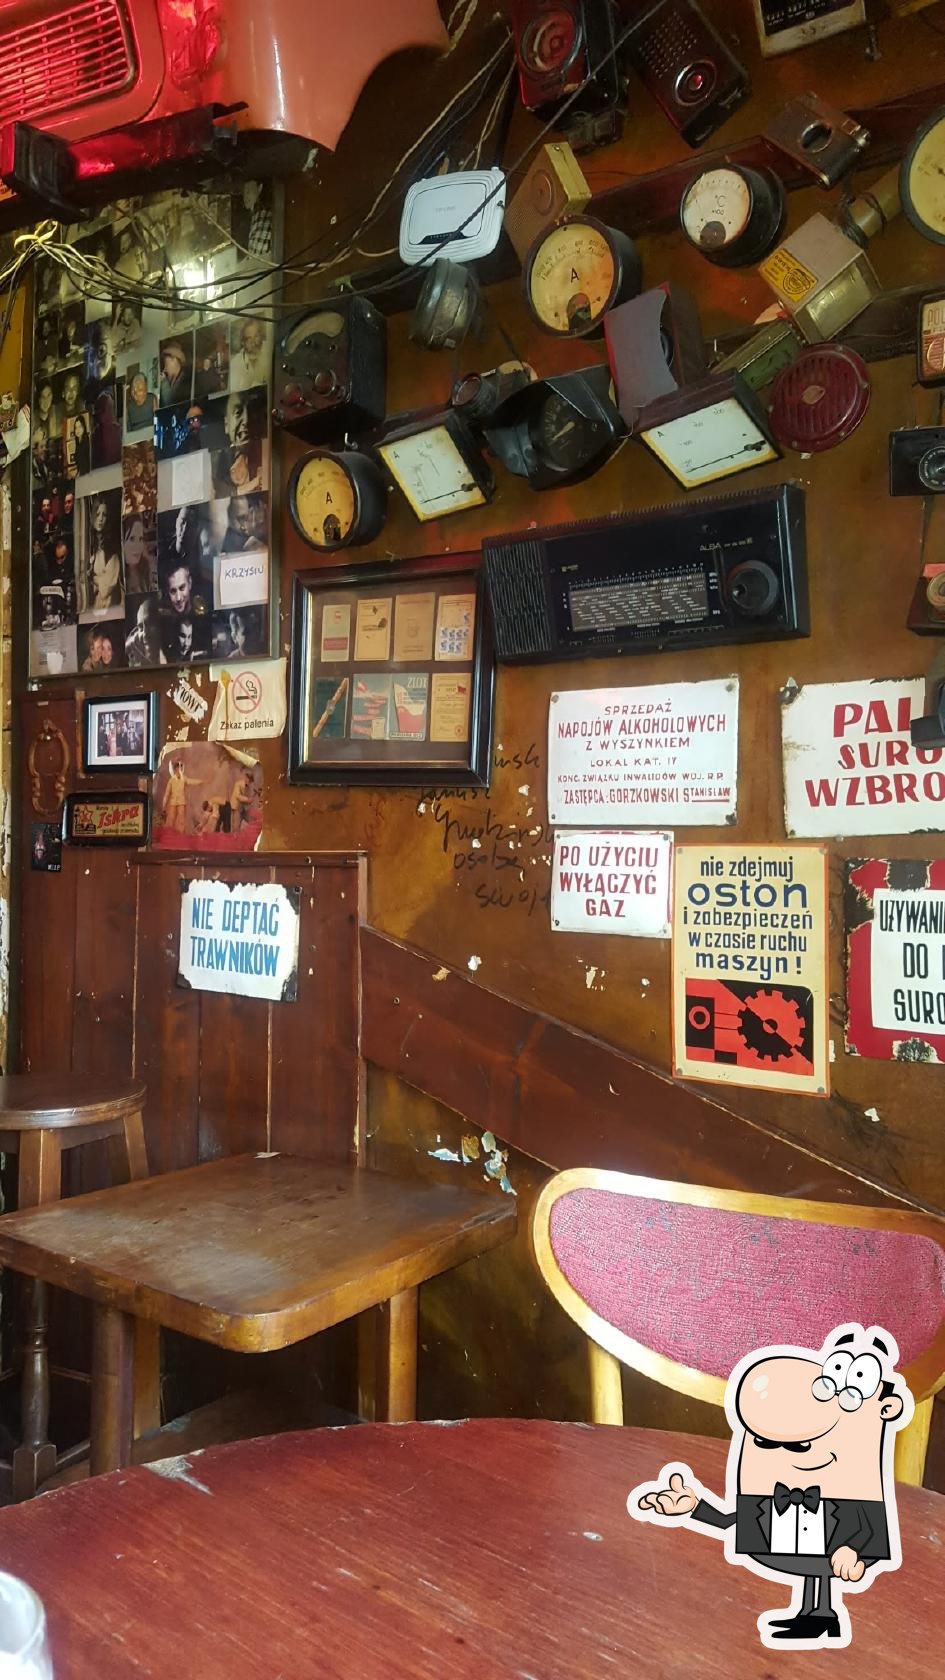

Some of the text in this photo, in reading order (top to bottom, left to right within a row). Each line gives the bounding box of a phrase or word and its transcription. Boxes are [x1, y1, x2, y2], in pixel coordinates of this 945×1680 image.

[570, 267, 580, 283] A
[325, 491, 333, 505] A
[604, 698, 672, 716] SPRZEDAŻ
[220, 718, 274, 731] Zakaz palenia
[558, 714, 726, 739] NAPOJÓW ALKOHOLOWYCH
[585, 737, 690, 751] Z WYSZYNKIEM
[590, 759, 628, 768] LOKAL
[634, 757, 661, 766] KAT.
[609, 787, 679, 804] GORZKOWSKI
[560, 841, 658, 867] PO UŻYCIU
[700, 856, 793, 882] nie zdejmuj
[559, 869, 657, 897] WYŁĄCZYĆ
[191, 897, 280, 937] NIE DEPTAĆ
[585, 898, 626, 917] GAZ
[683, 906, 813, 930] i zabezpieczeń
[879, 899, 945, 934] UŻYWANI
[705, 932, 756, 950] czasie
[760, 931, 807, 952] ruchu
[190, 935, 280, 977] TRAWNIKÓW
[695, 952, 788, 981] maszyn
[903, 942, 929, 979] DO
